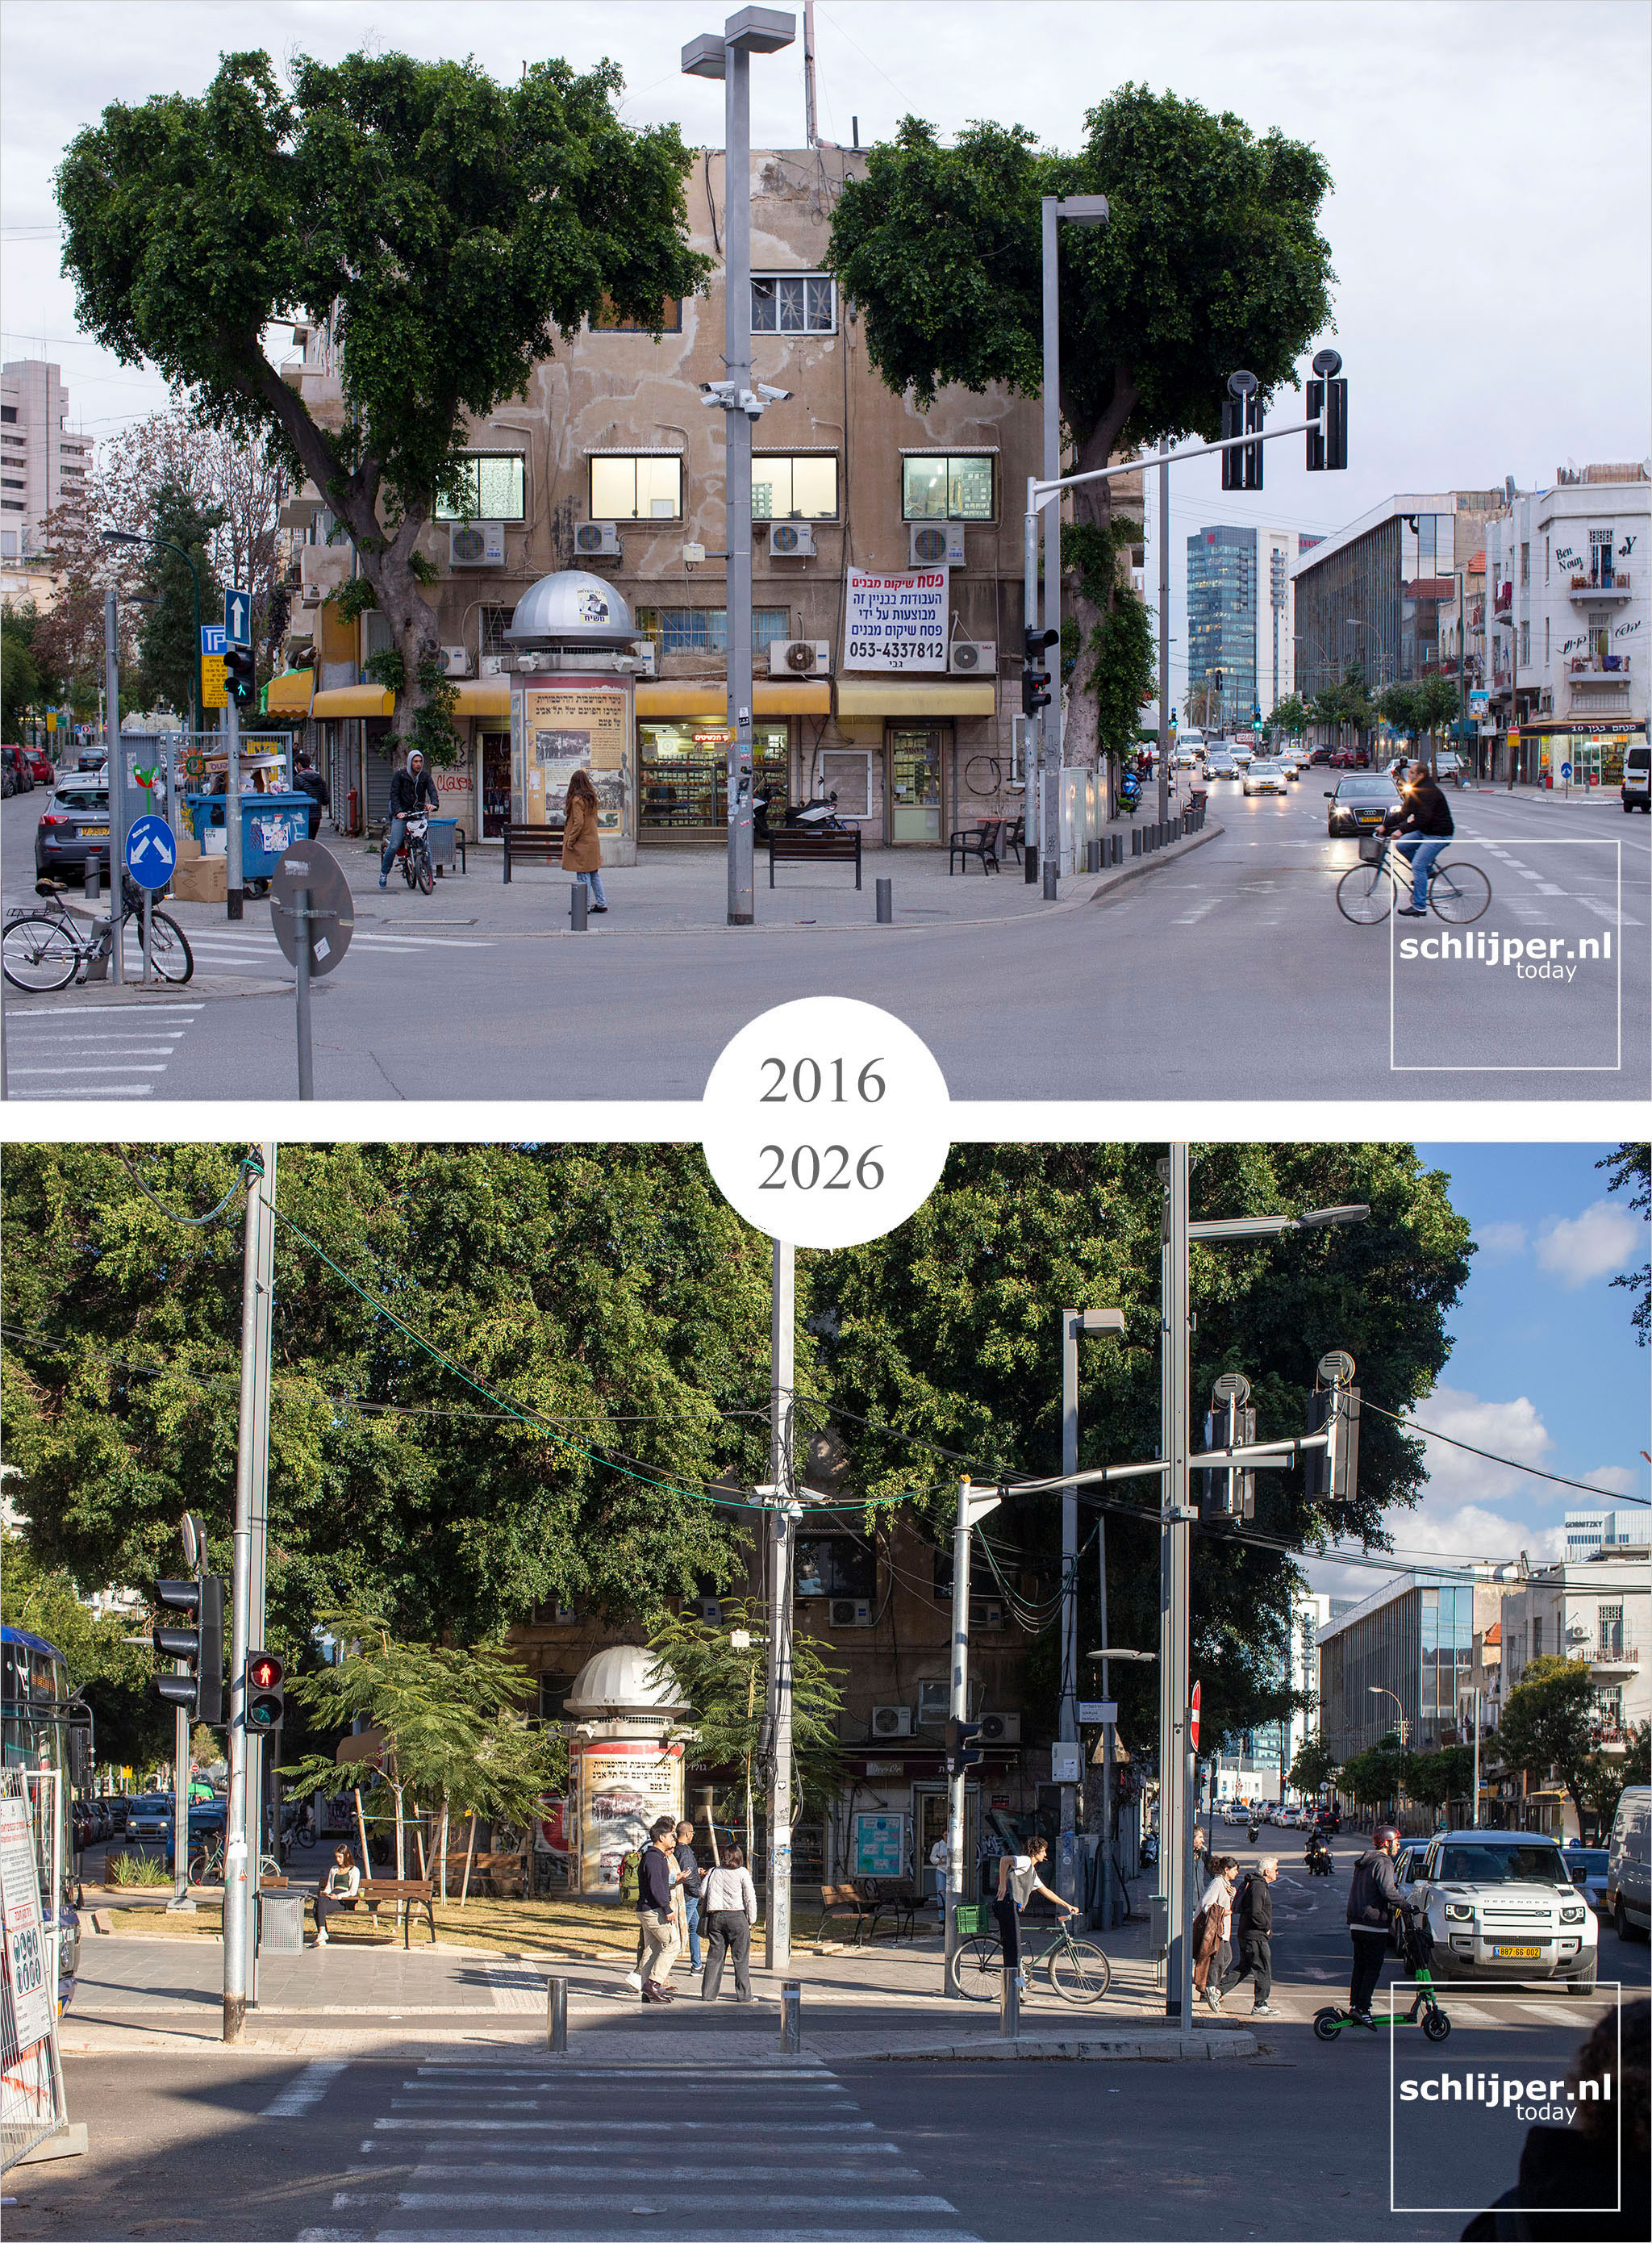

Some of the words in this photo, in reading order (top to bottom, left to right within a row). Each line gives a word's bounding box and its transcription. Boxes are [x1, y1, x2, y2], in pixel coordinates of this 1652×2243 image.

[1556, 547, 1573, 560] Ben
[852, 578, 881, 588] מבנים
[884, 580, 915, 591] שיקום
[917, 574, 944, 588] פסח
[853, 593, 866, 604] זה
[868, 593, 897, 608] בבניין
[899, 593, 942, 605] העבודות
[859, 609, 872, 620] ידי
[876, 607, 889, 620] על
[892, 610, 936, 620] מבוצעות
[851, 625, 881, 636] מבנים
[885, 625, 916, 639] שיקום
[920, 626, 943, 636] פסח
[850, 642, 943, 658] 053-4337812
